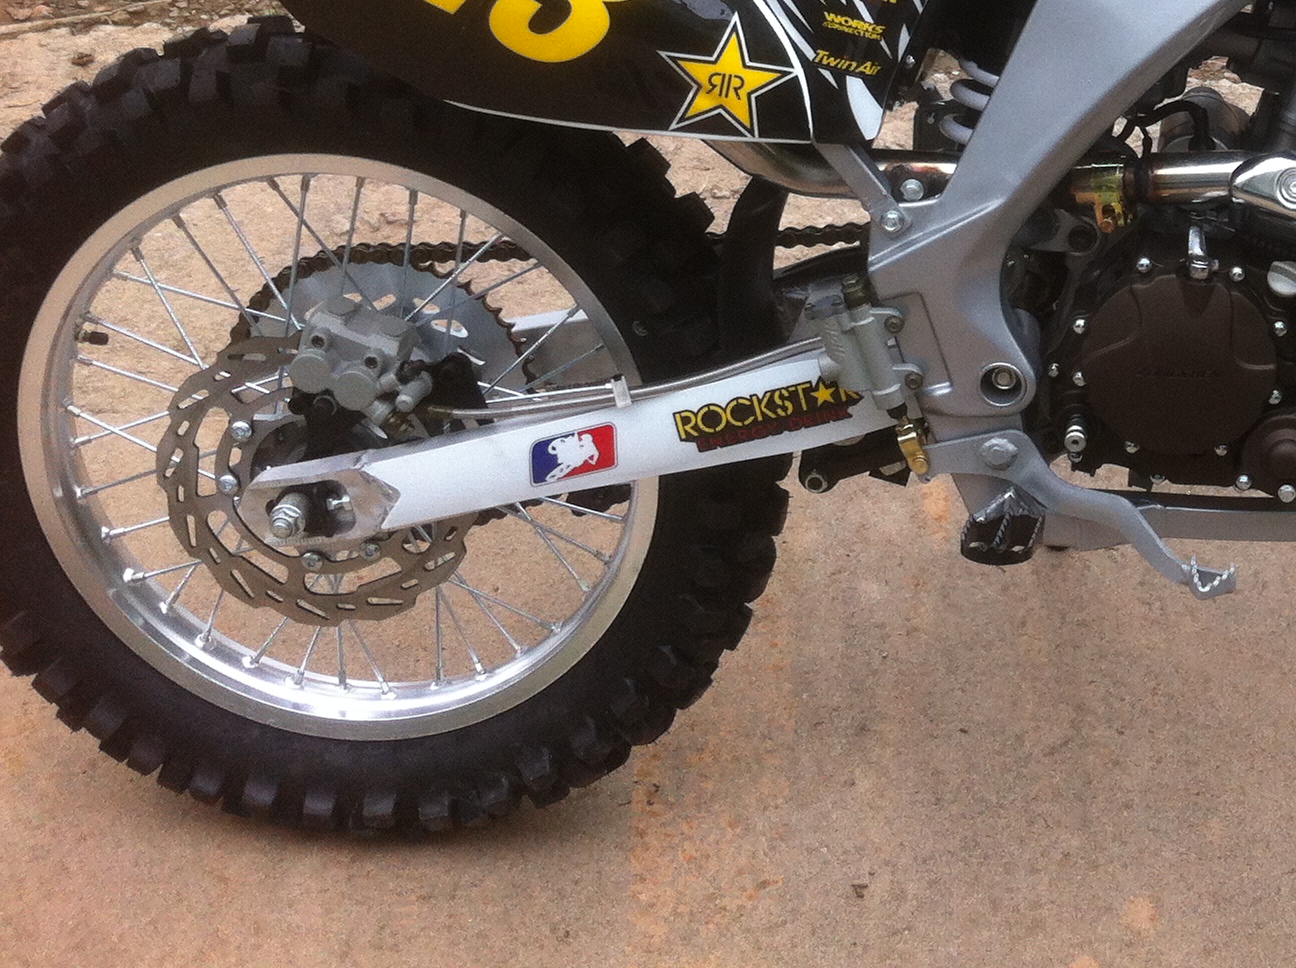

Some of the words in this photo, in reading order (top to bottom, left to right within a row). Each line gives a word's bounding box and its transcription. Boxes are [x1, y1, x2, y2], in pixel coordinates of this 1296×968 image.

[822, 21, 883, 41] CONNECTION
[824, 12, 886, 33] WORKS
[814, 49, 856, 72] Twin
[856, 61, 883, 76] Air
